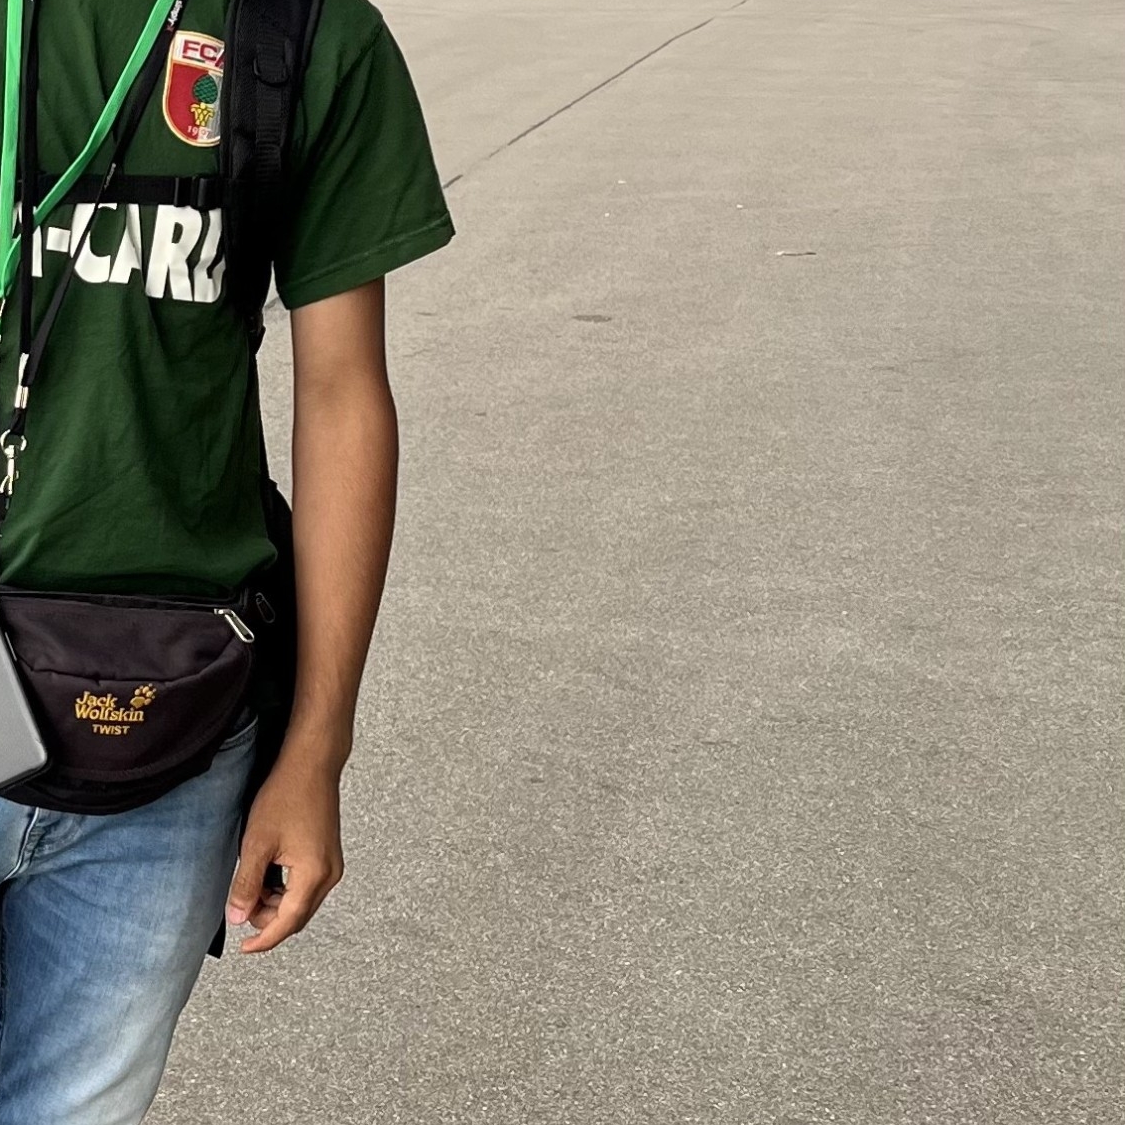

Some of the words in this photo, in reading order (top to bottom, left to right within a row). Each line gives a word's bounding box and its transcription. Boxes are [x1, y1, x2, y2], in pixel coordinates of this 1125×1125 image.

[76, 691, 118, 707] Jack
[75, 704, 144, 722] Wolfskin
[92, 724, 130, 735] TWIST
